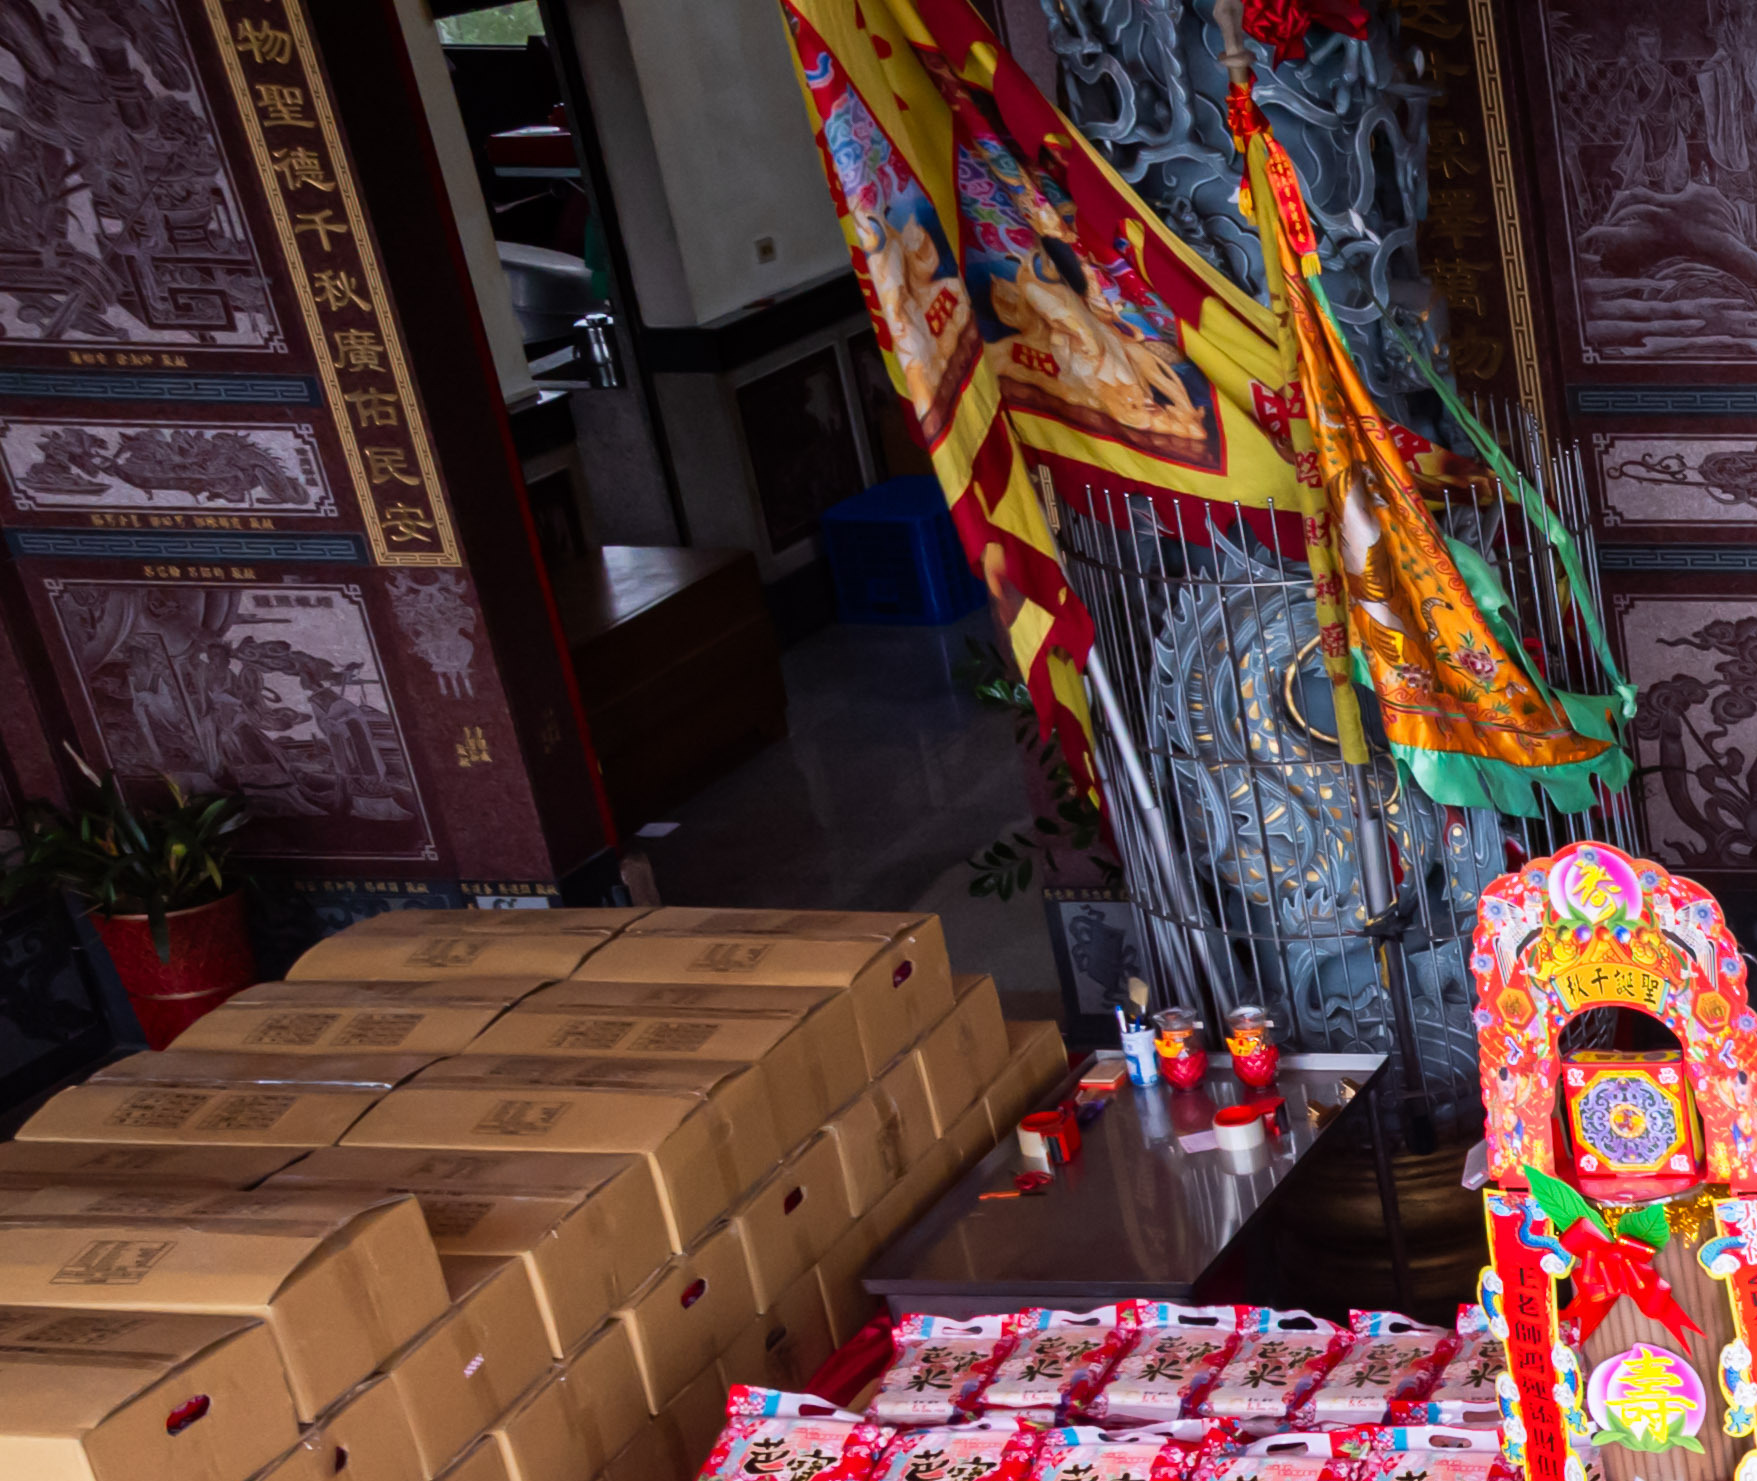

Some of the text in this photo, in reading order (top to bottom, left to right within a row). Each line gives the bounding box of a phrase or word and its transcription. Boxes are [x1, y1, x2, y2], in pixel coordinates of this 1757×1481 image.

[237, 0, 434, 544] 物聖德千秋廣佑民安
[906, 1368, 952, 1392] 米
[1019, 1358, 1063, 1384] 米
[1138, 1356, 1185, 1385] 米
[1240, 1364, 1286, 1390] 米
[1347, 1362, 1390, 1389] 米
[1606, 1348, 1697, 1445] 壽
